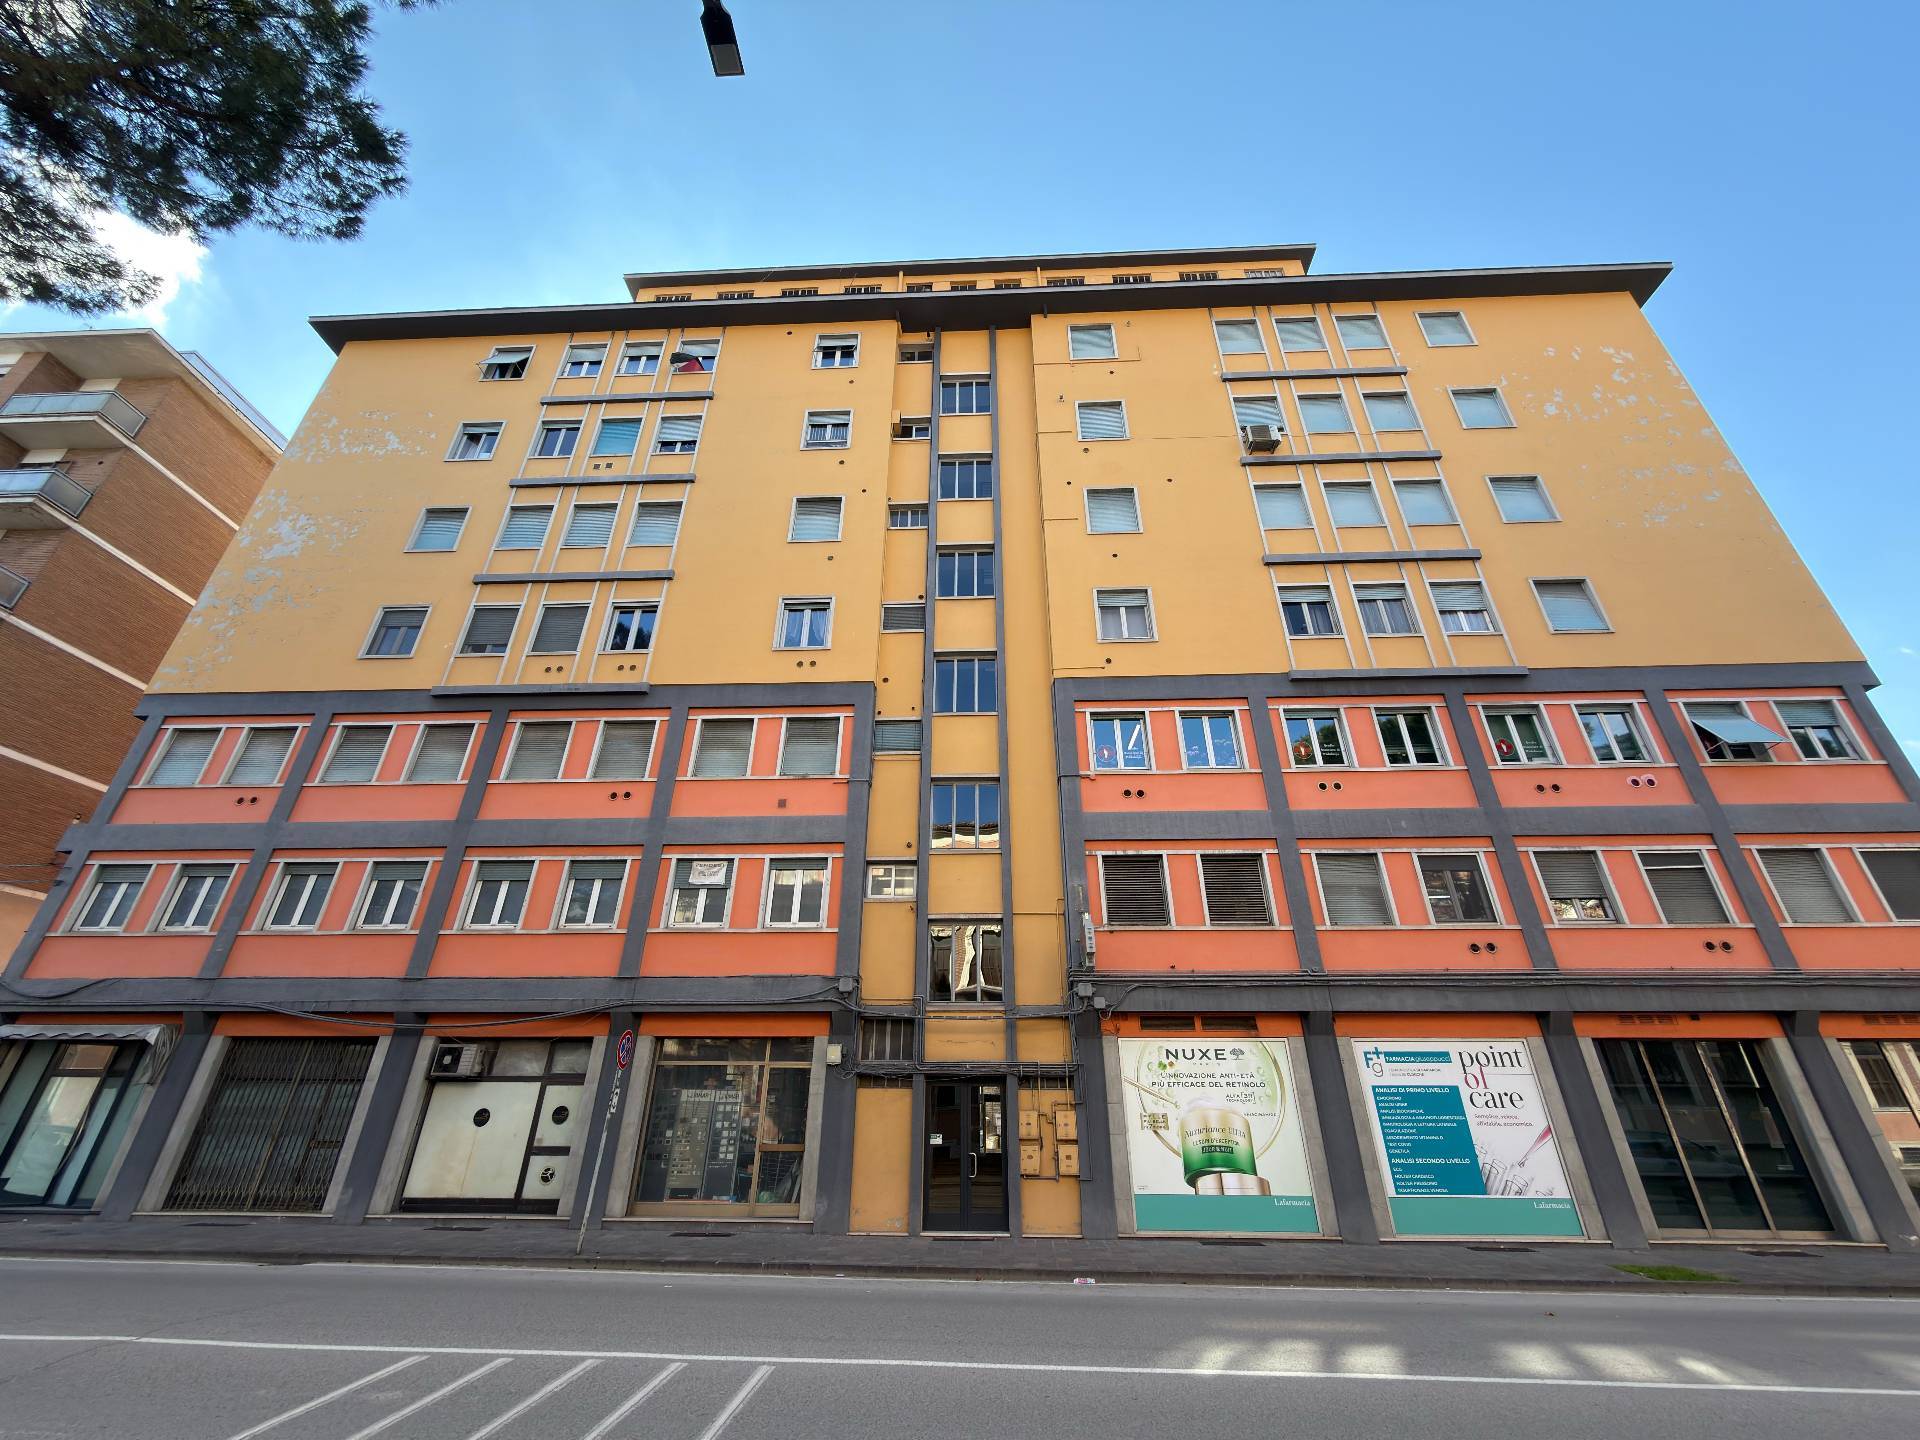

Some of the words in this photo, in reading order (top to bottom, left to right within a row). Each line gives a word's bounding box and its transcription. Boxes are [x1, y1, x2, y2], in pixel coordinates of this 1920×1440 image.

[1165, 1048, 1227, 1060] NUXE
[1458, 1046, 1524, 1075] point
[1151, 1080, 1164, 1088] PIÙ
[1465, 1066, 1489, 1089] of
[1470, 1092, 1524, 1109] care
